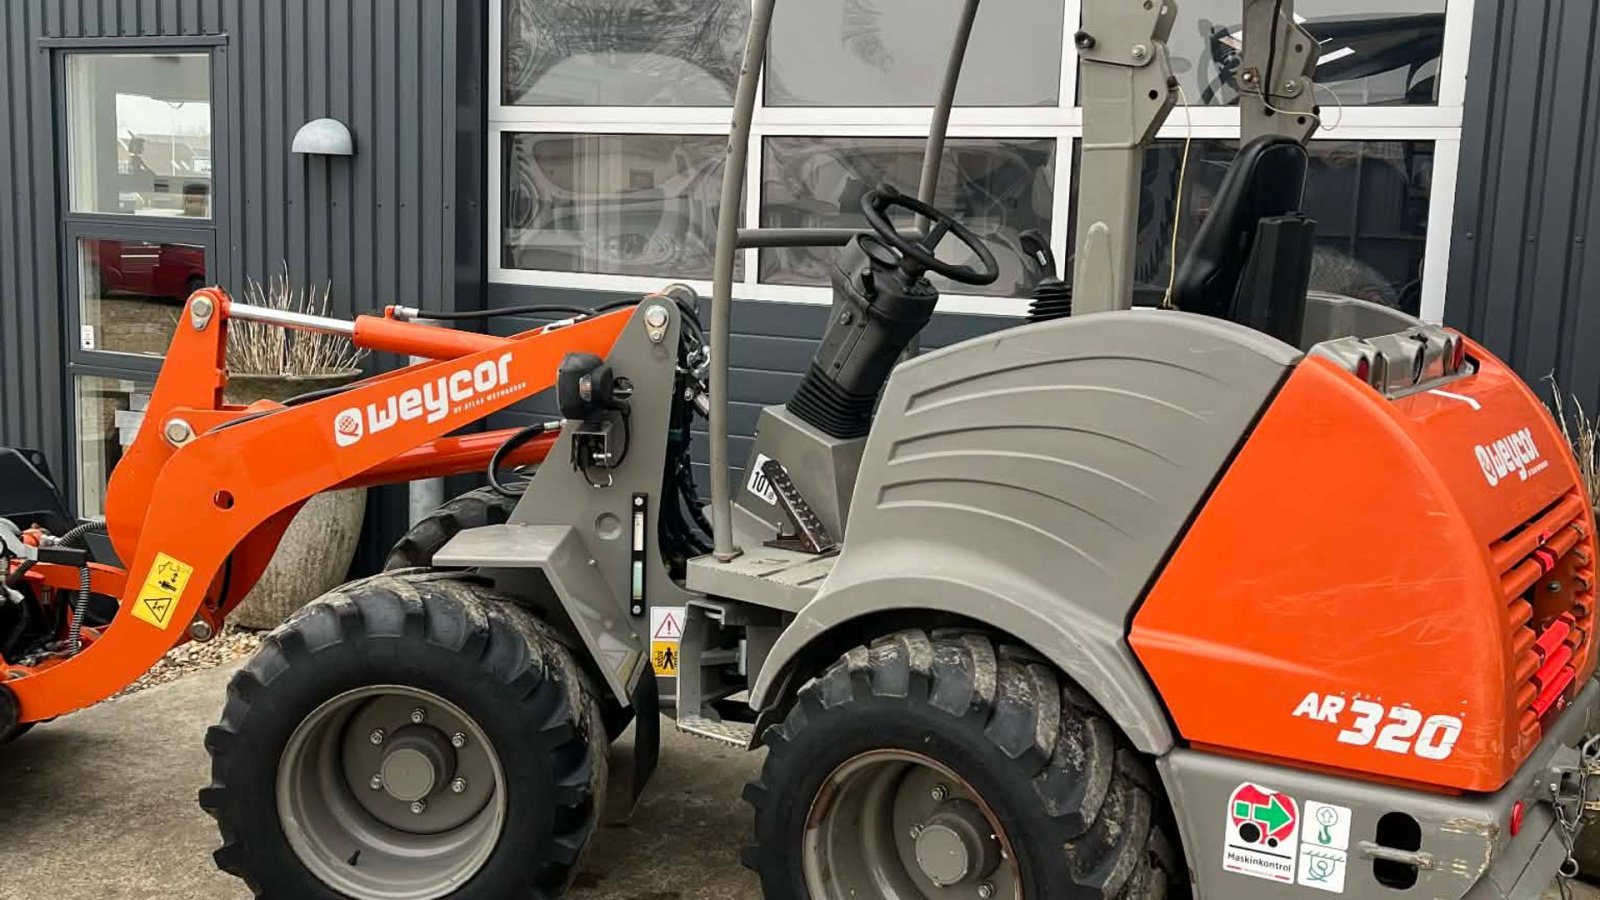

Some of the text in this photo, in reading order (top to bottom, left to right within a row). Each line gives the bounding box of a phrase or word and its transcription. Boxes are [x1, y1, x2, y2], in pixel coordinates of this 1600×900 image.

[366, 352, 512, 434] weycor
[1485, 427, 1540, 481] weycor
[1291, 691, 1463, 760] AR 320
[1227, 852, 1292, 872] Maskinkontrol
